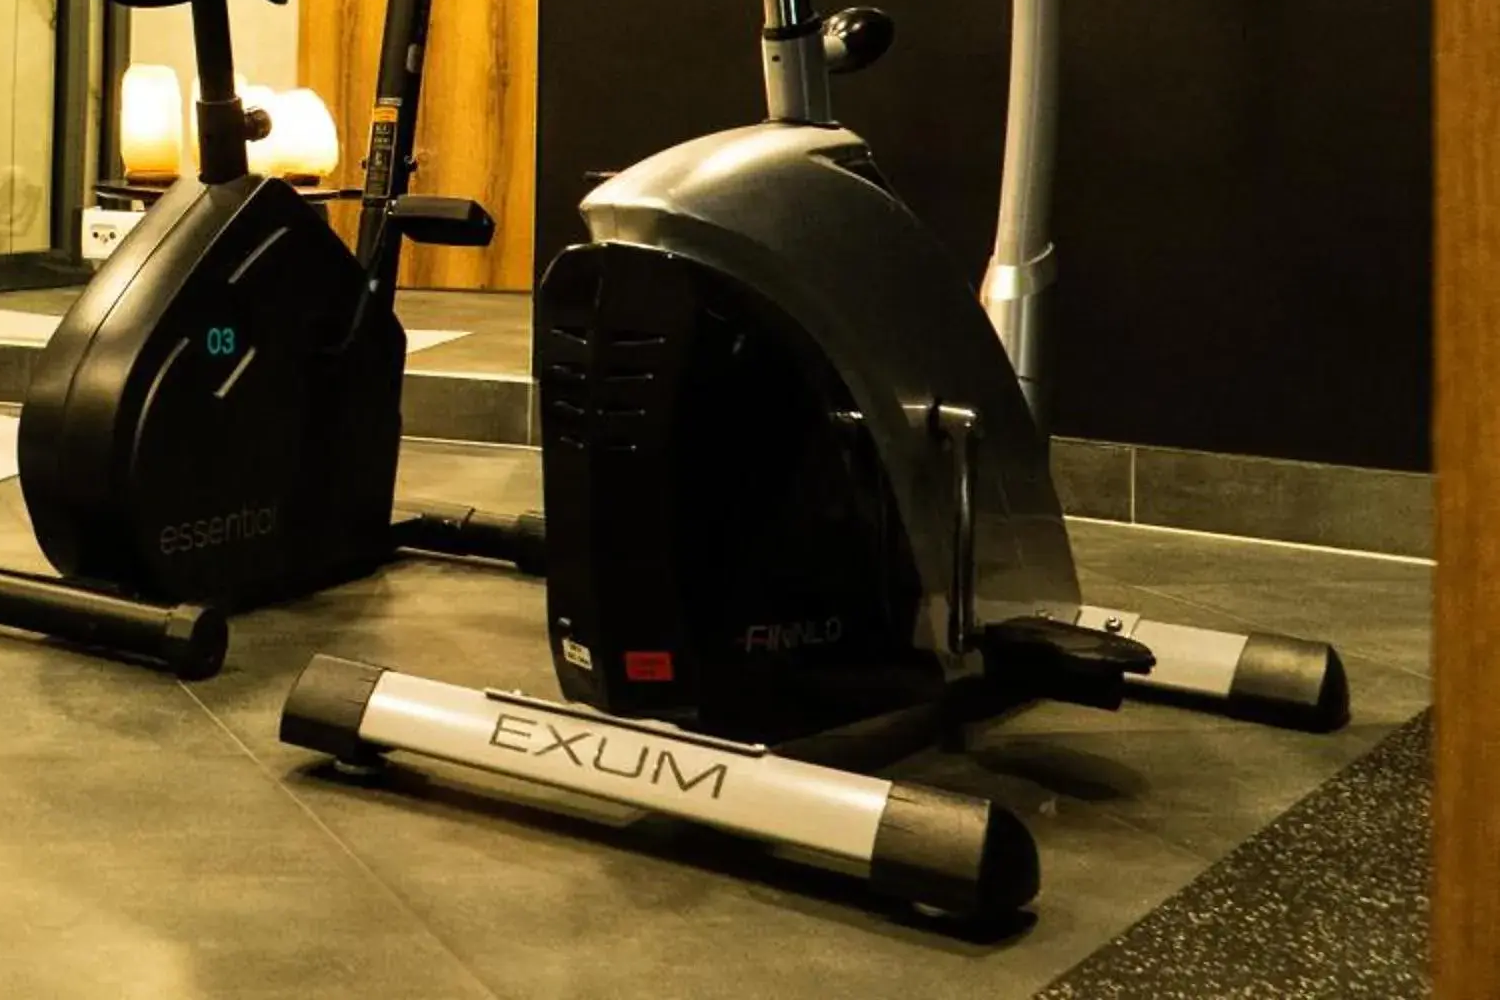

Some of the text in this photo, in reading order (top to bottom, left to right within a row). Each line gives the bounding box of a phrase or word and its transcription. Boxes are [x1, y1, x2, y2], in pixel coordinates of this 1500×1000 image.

[206, 326, 235, 355] 03
[160, 499, 278, 556] essential
[488, 712, 729, 799] EXUM
